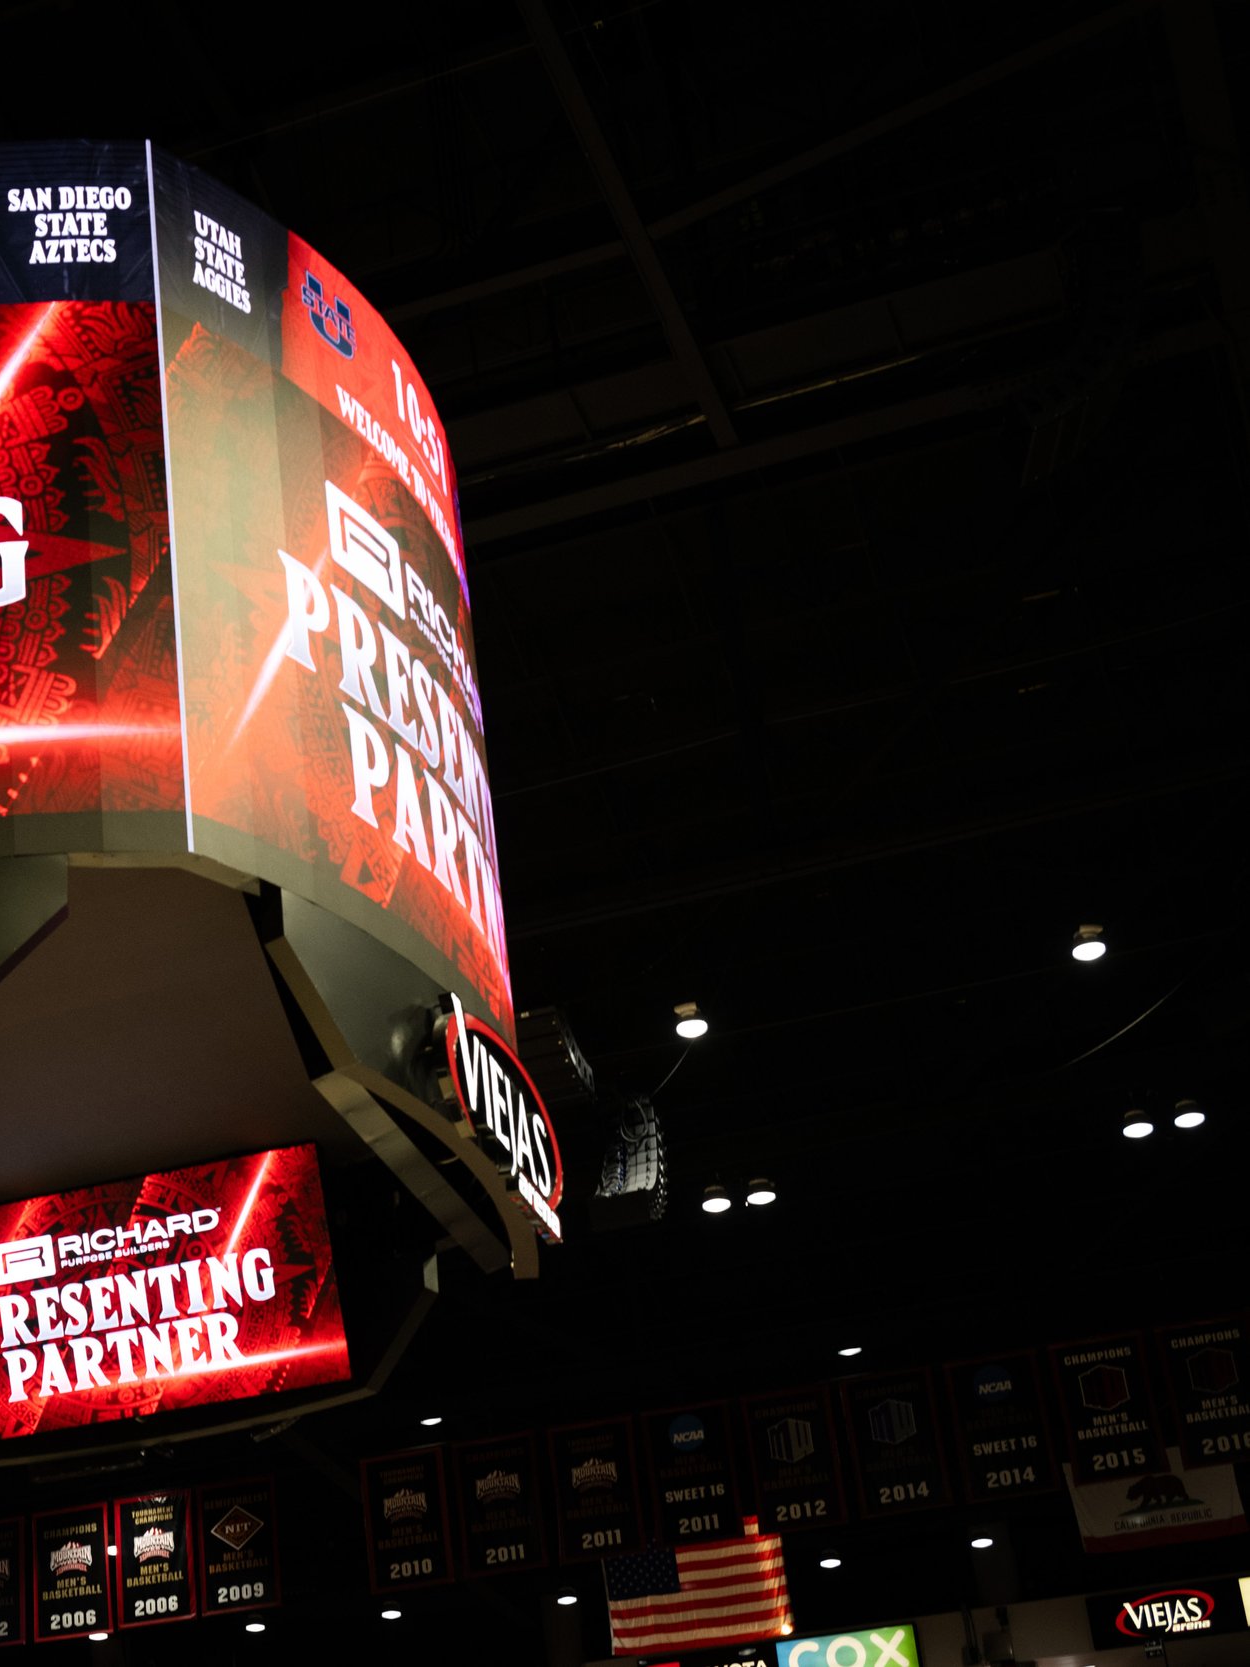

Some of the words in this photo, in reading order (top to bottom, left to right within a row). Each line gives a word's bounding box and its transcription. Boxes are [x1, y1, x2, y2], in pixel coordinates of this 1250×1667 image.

[7, 187, 52, 213] SAN
[58, 186, 132, 211] DIEGO
[34, 211, 108, 237] STATE
[194, 210, 243, 260] UTAH
[29, 239, 117, 265] AZTECS
[194, 236, 247, 287] STATE
[193, 261, 252, 315] AGGIES
[391, 358, 448, 497] 10:51
[335, 383, 411, 487] WELCOME
[411, 465, 428, 507] TO
[451, 991, 551, 1198] VIEJAS
[58, 1208, 220, 1258] RICHARD
[60, 1251, 113, 1269] PURPOSE
[114, 1240, 171, 1260] BUILDERS
[1170, 1328, 1241, 1350] CHAMPIONS
[2, 1312, 247, 1403] PARTNER
[1063, 1346, 1132, 1367] CHAMPIONS
[978, 1379, 1013, 1396] NCAA
[1201, 1394, 1239, 1410] MEN'S
[1092, 1411, 1129, 1426] MEN'S
[1185, 1404, 1250, 1425] BASKETBAL
[672, 1428, 705, 1444] NCAA
[1077, 1420, 1149, 1441] BASKETBALL
[973, 1437, 1017, 1457] SWEET
[1021, 1435, 1038, 1449] 16
[1092, 1448, 1147, 1472] 2015
[571, 1460, 618, 1486] MOUNTAIN
[986, 1465, 1036, 1489] 2014
[475, 1473, 521, 1497] MOUNTAIN
[665, 1485, 706, 1504] SWEET
[710, 1482, 725, 1496] 16
[879, 1480, 930, 1504] 2014
[132, 1505, 174, 1519] TOURNAMENT
[383, 1490, 427, 1516] MOUNTAIN
[775, 1499, 827, 1523] 2012
[134, 1513, 173, 1526] CHAMPIONS
[678, 1513, 720, 1535] 2011
[1170, 1507, 1213, 1525] REPUBLIC
[43, 1522, 98, 1540] CHAMPIONS
[224, 1521, 252, 1535] NIT
[581, 1528, 623, 1550] 2011
[133, 1531, 175, 1555] MOUNTAIN
[377, 1532, 439, 1551] BASKETBALL
[50, 1544, 93, 1568] MOUNTAIN
[222, 1549, 256, 1562] MEN'S
[485, 1543, 526, 1565] 2011
[139, 1562, 170, 1576] MEN'S
[208, 1557, 270, 1575] BASKETBALL
[389, 1557, 433, 1580] 2010
[56, 1576, 87, 1590] MEN'S
[126, 1570, 184, 1588] BASKETBALL
[42, 1584, 103, 1601] BASKETBALL
[217, 1581, 266, 1605] 2009
[134, 1595, 179, 1617] 2006
[1123, 1597, 1203, 1632] VIEJAS
[50, 1609, 97, 1630] 2006
[1172, 1619, 1212, 1633] arena
[788, 1629, 910, 1667] COX
